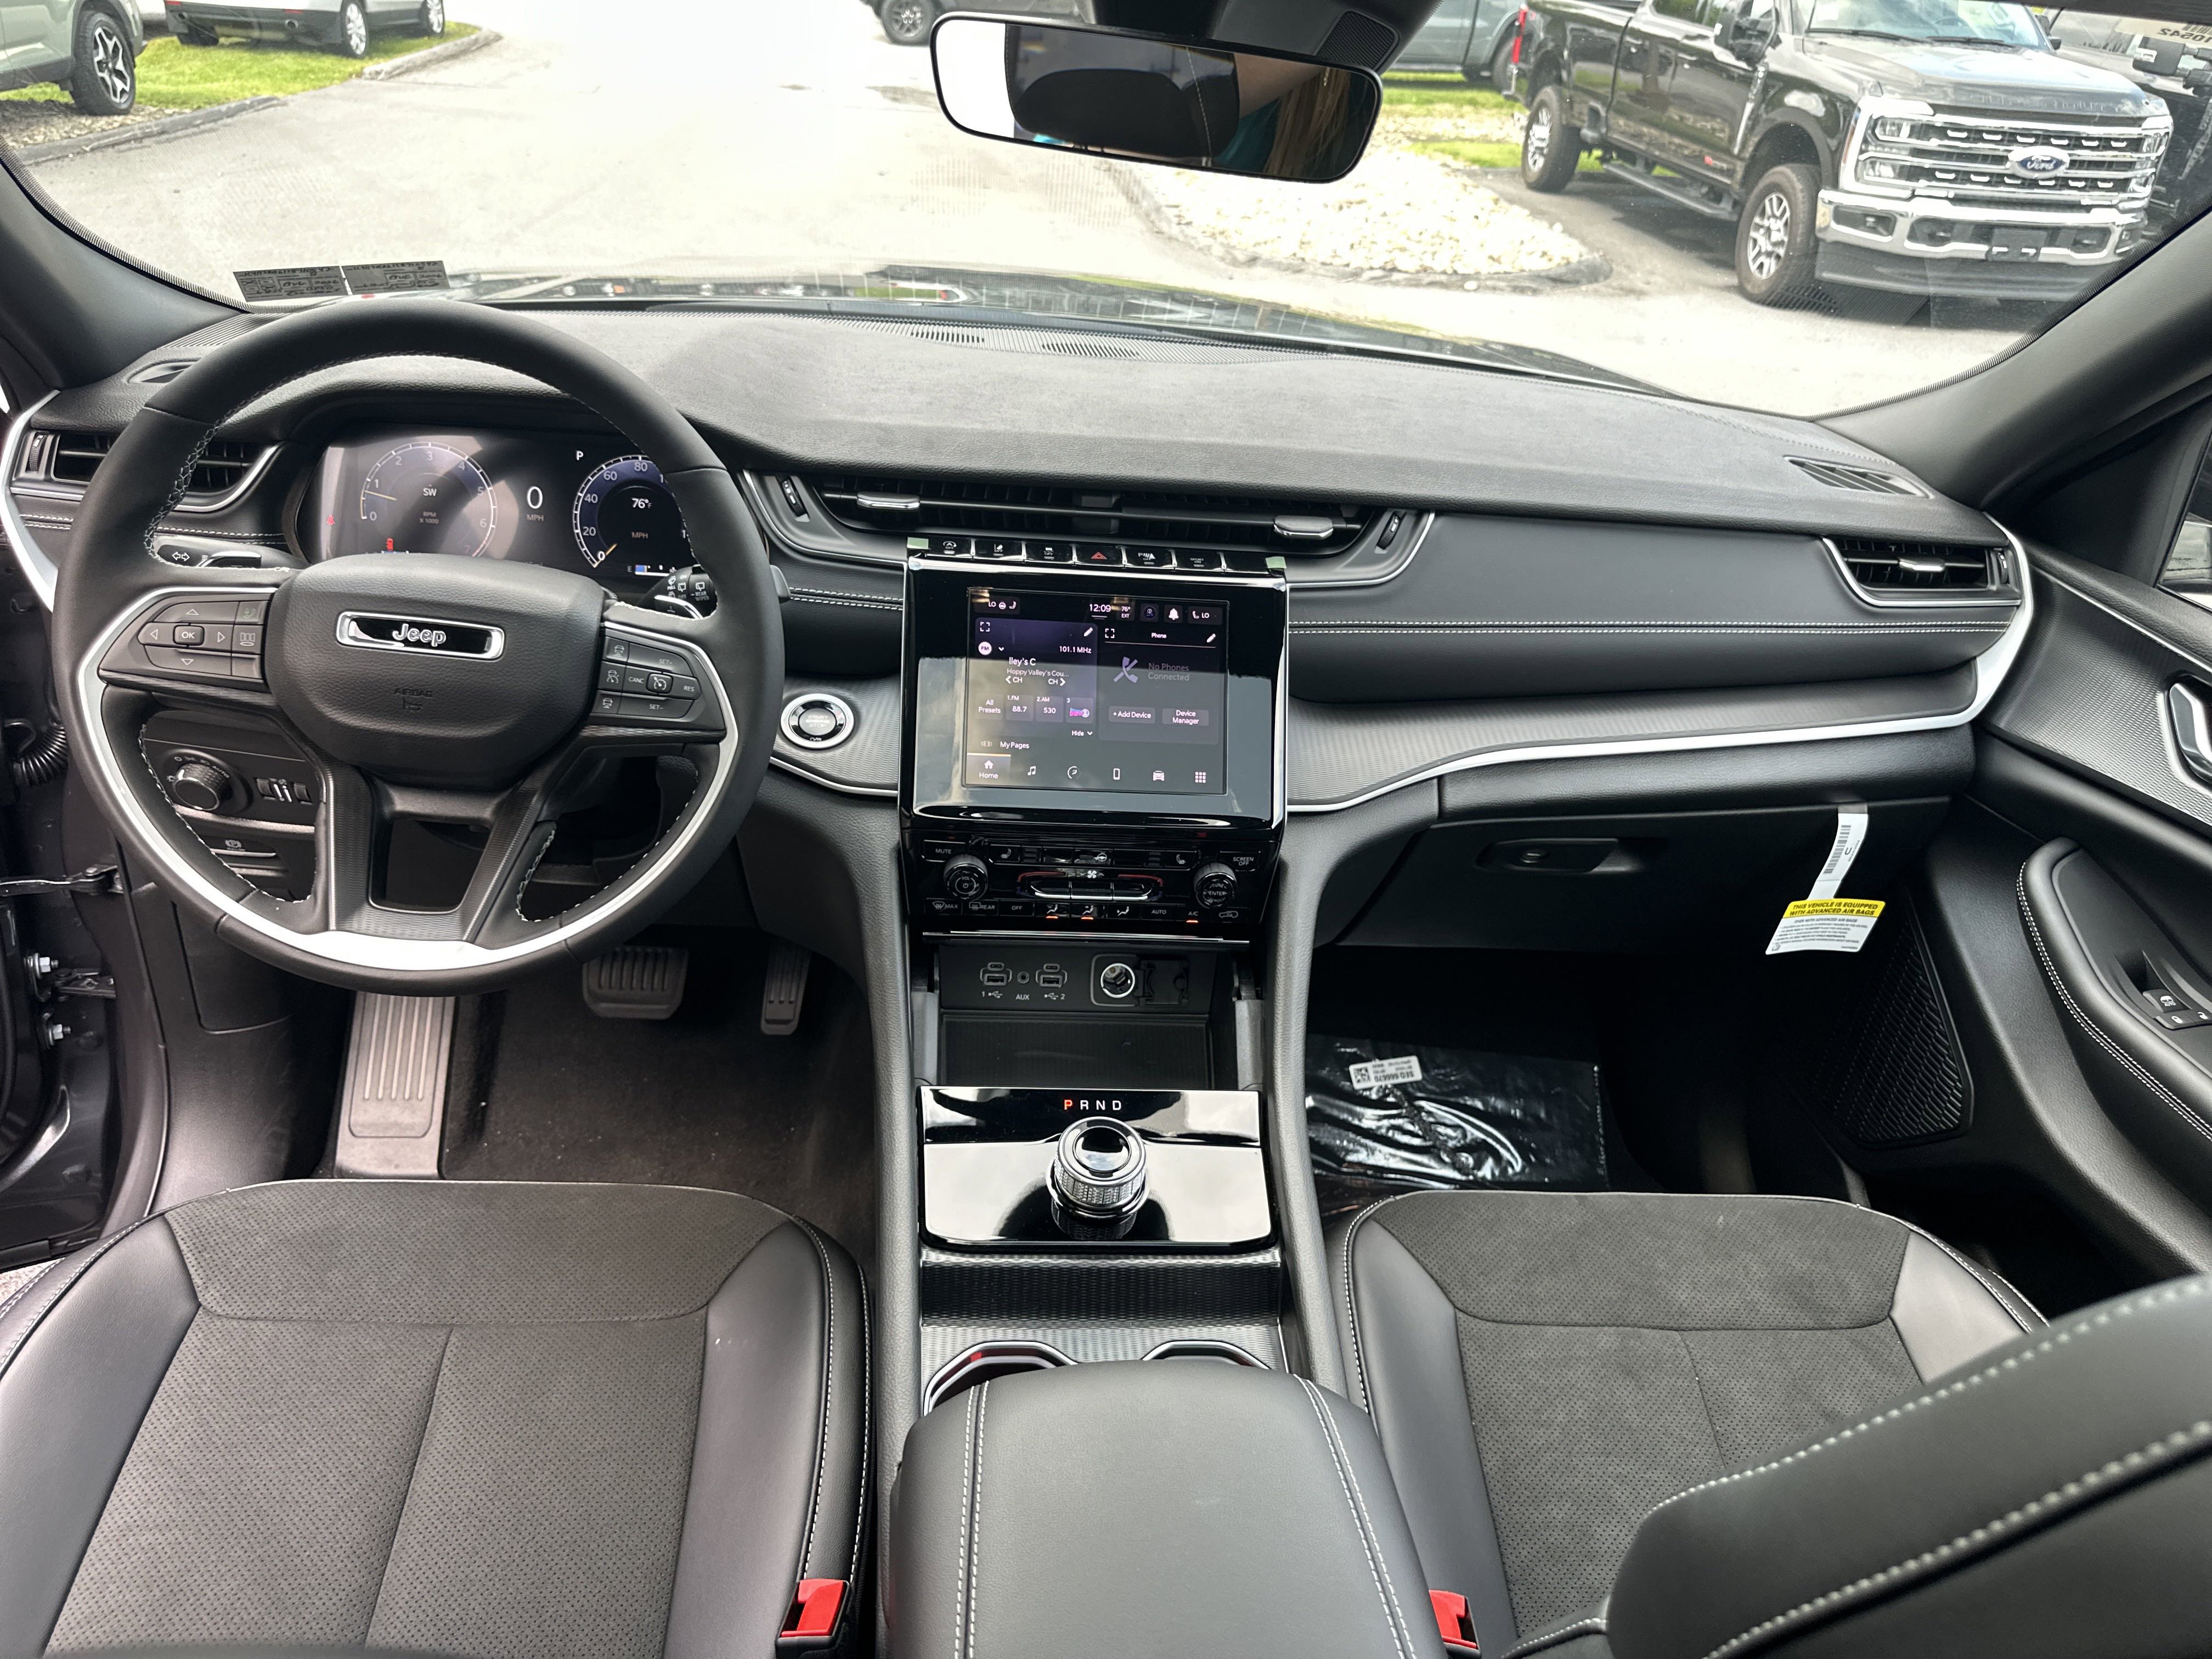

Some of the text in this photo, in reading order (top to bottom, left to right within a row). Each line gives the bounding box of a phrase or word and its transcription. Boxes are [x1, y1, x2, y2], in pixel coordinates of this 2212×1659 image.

[427, 452, 433, 460] 3
[576, 450, 584, 461] P
[396, 456, 402, 466] 2
[459, 461, 465, 470] 4
[634, 462, 648, 472] 80
[603, 471, 617, 481] 60
[374, 479, 379, 488] 1
[423, 488, 437, 496] SW
[478, 487, 484, 495] 5
[527, 486, 543, 509] 0
[584, 494, 598, 504] 40
[369, 511, 377, 521] 0
[480, 518, 487, 527] 6
[583, 526, 596, 536] 20
[597, 551, 605, 561] 0
[1089, 604, 1111, 612] 12:09
[182, 631, 195, 639] OK
[392, 623, 447, 647] Jeep
[1148, 673, 1189, 681] Connected
[1064, 1099, 1121, 1110] P R N D
